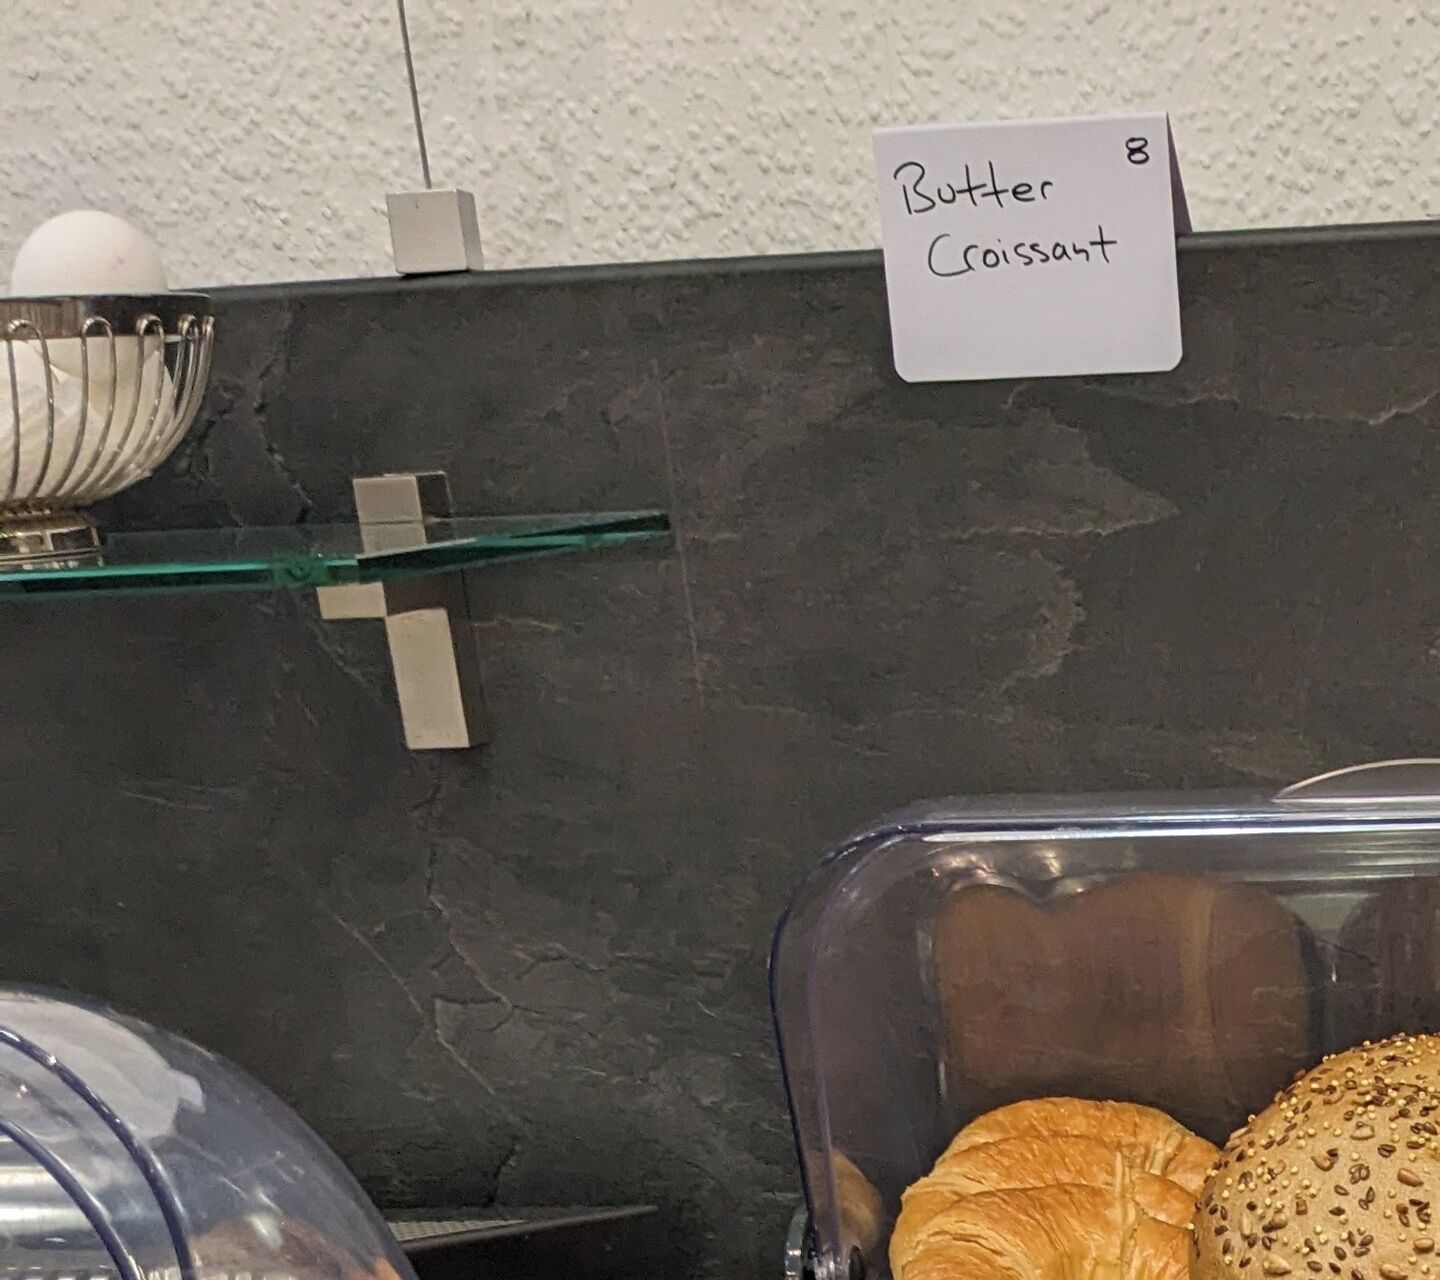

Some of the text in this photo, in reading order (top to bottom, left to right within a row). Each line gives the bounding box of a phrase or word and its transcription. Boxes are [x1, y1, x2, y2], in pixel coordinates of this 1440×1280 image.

[1125, 137, 1149, 165] 8
[894, 161, 1053, 215] Butter
[927, 225, 1117, 277] Croissant
